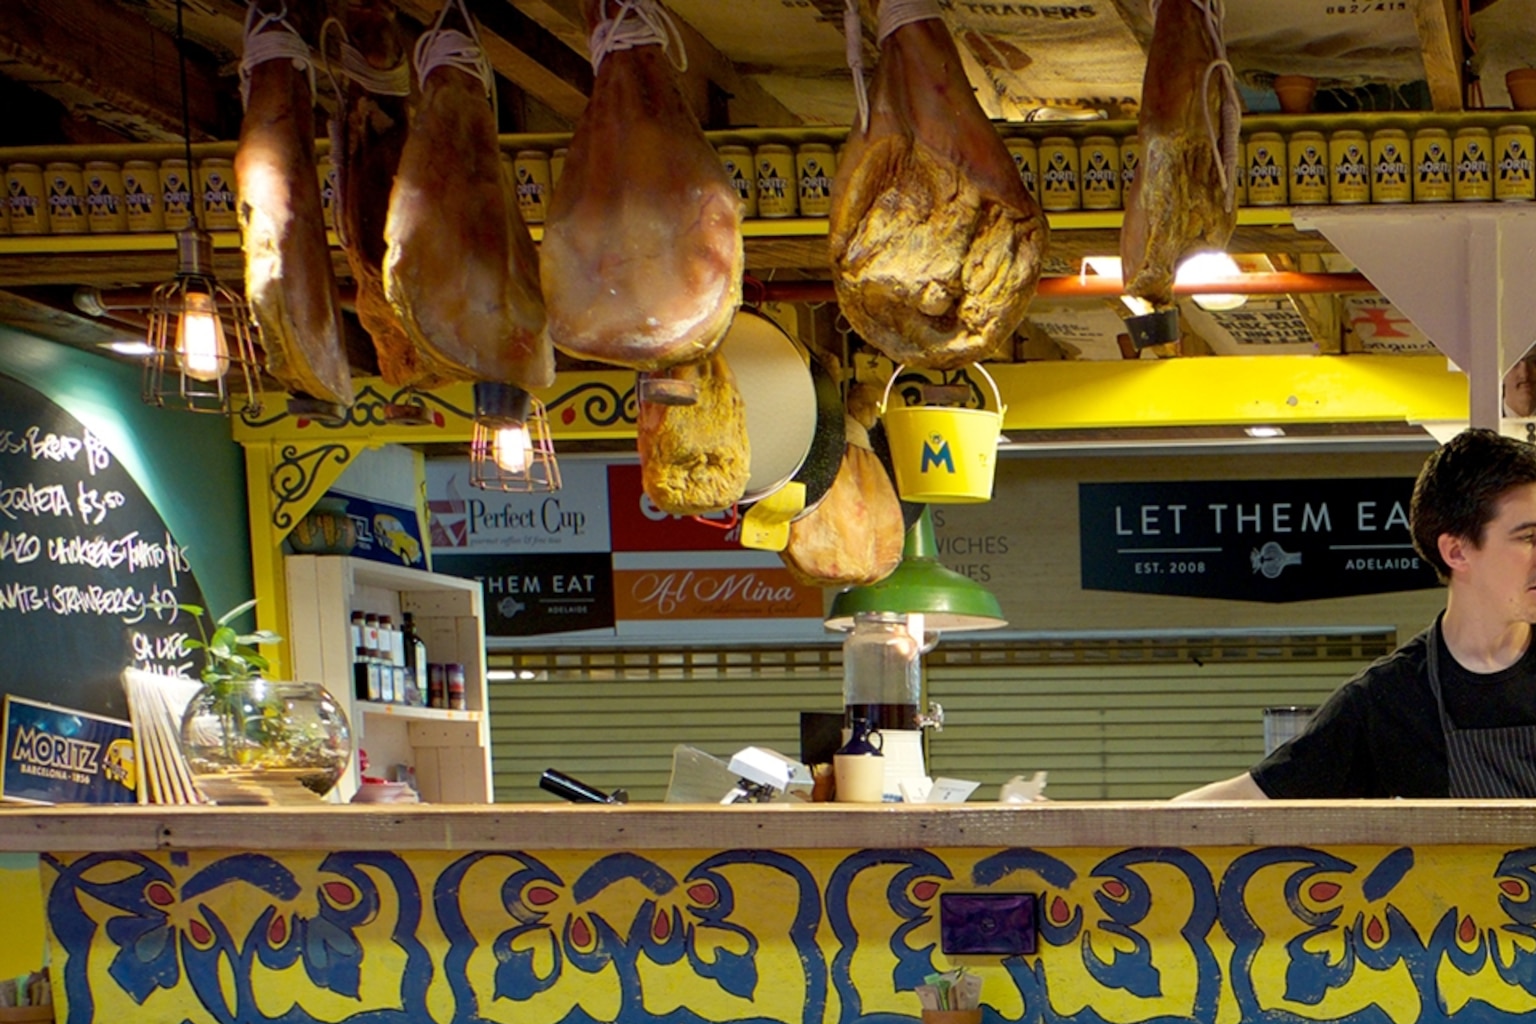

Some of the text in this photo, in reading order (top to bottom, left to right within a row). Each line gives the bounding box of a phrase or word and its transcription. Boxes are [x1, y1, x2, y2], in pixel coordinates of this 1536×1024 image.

[468, 497, 586, 535] Perfect Cup
[1115, 501, 1412, 536] LET THEM EA
[1135, 561, 1207, 575] EST. 2008
[1344, 557, 1421, 571] ADELAIDE
[552, 574, 595, 593] EAT
[694, 573, 796, 602] Mina
[548, 605, 588, 614] ADELAIDE
[12, 724, 101, 775] MORITZ
